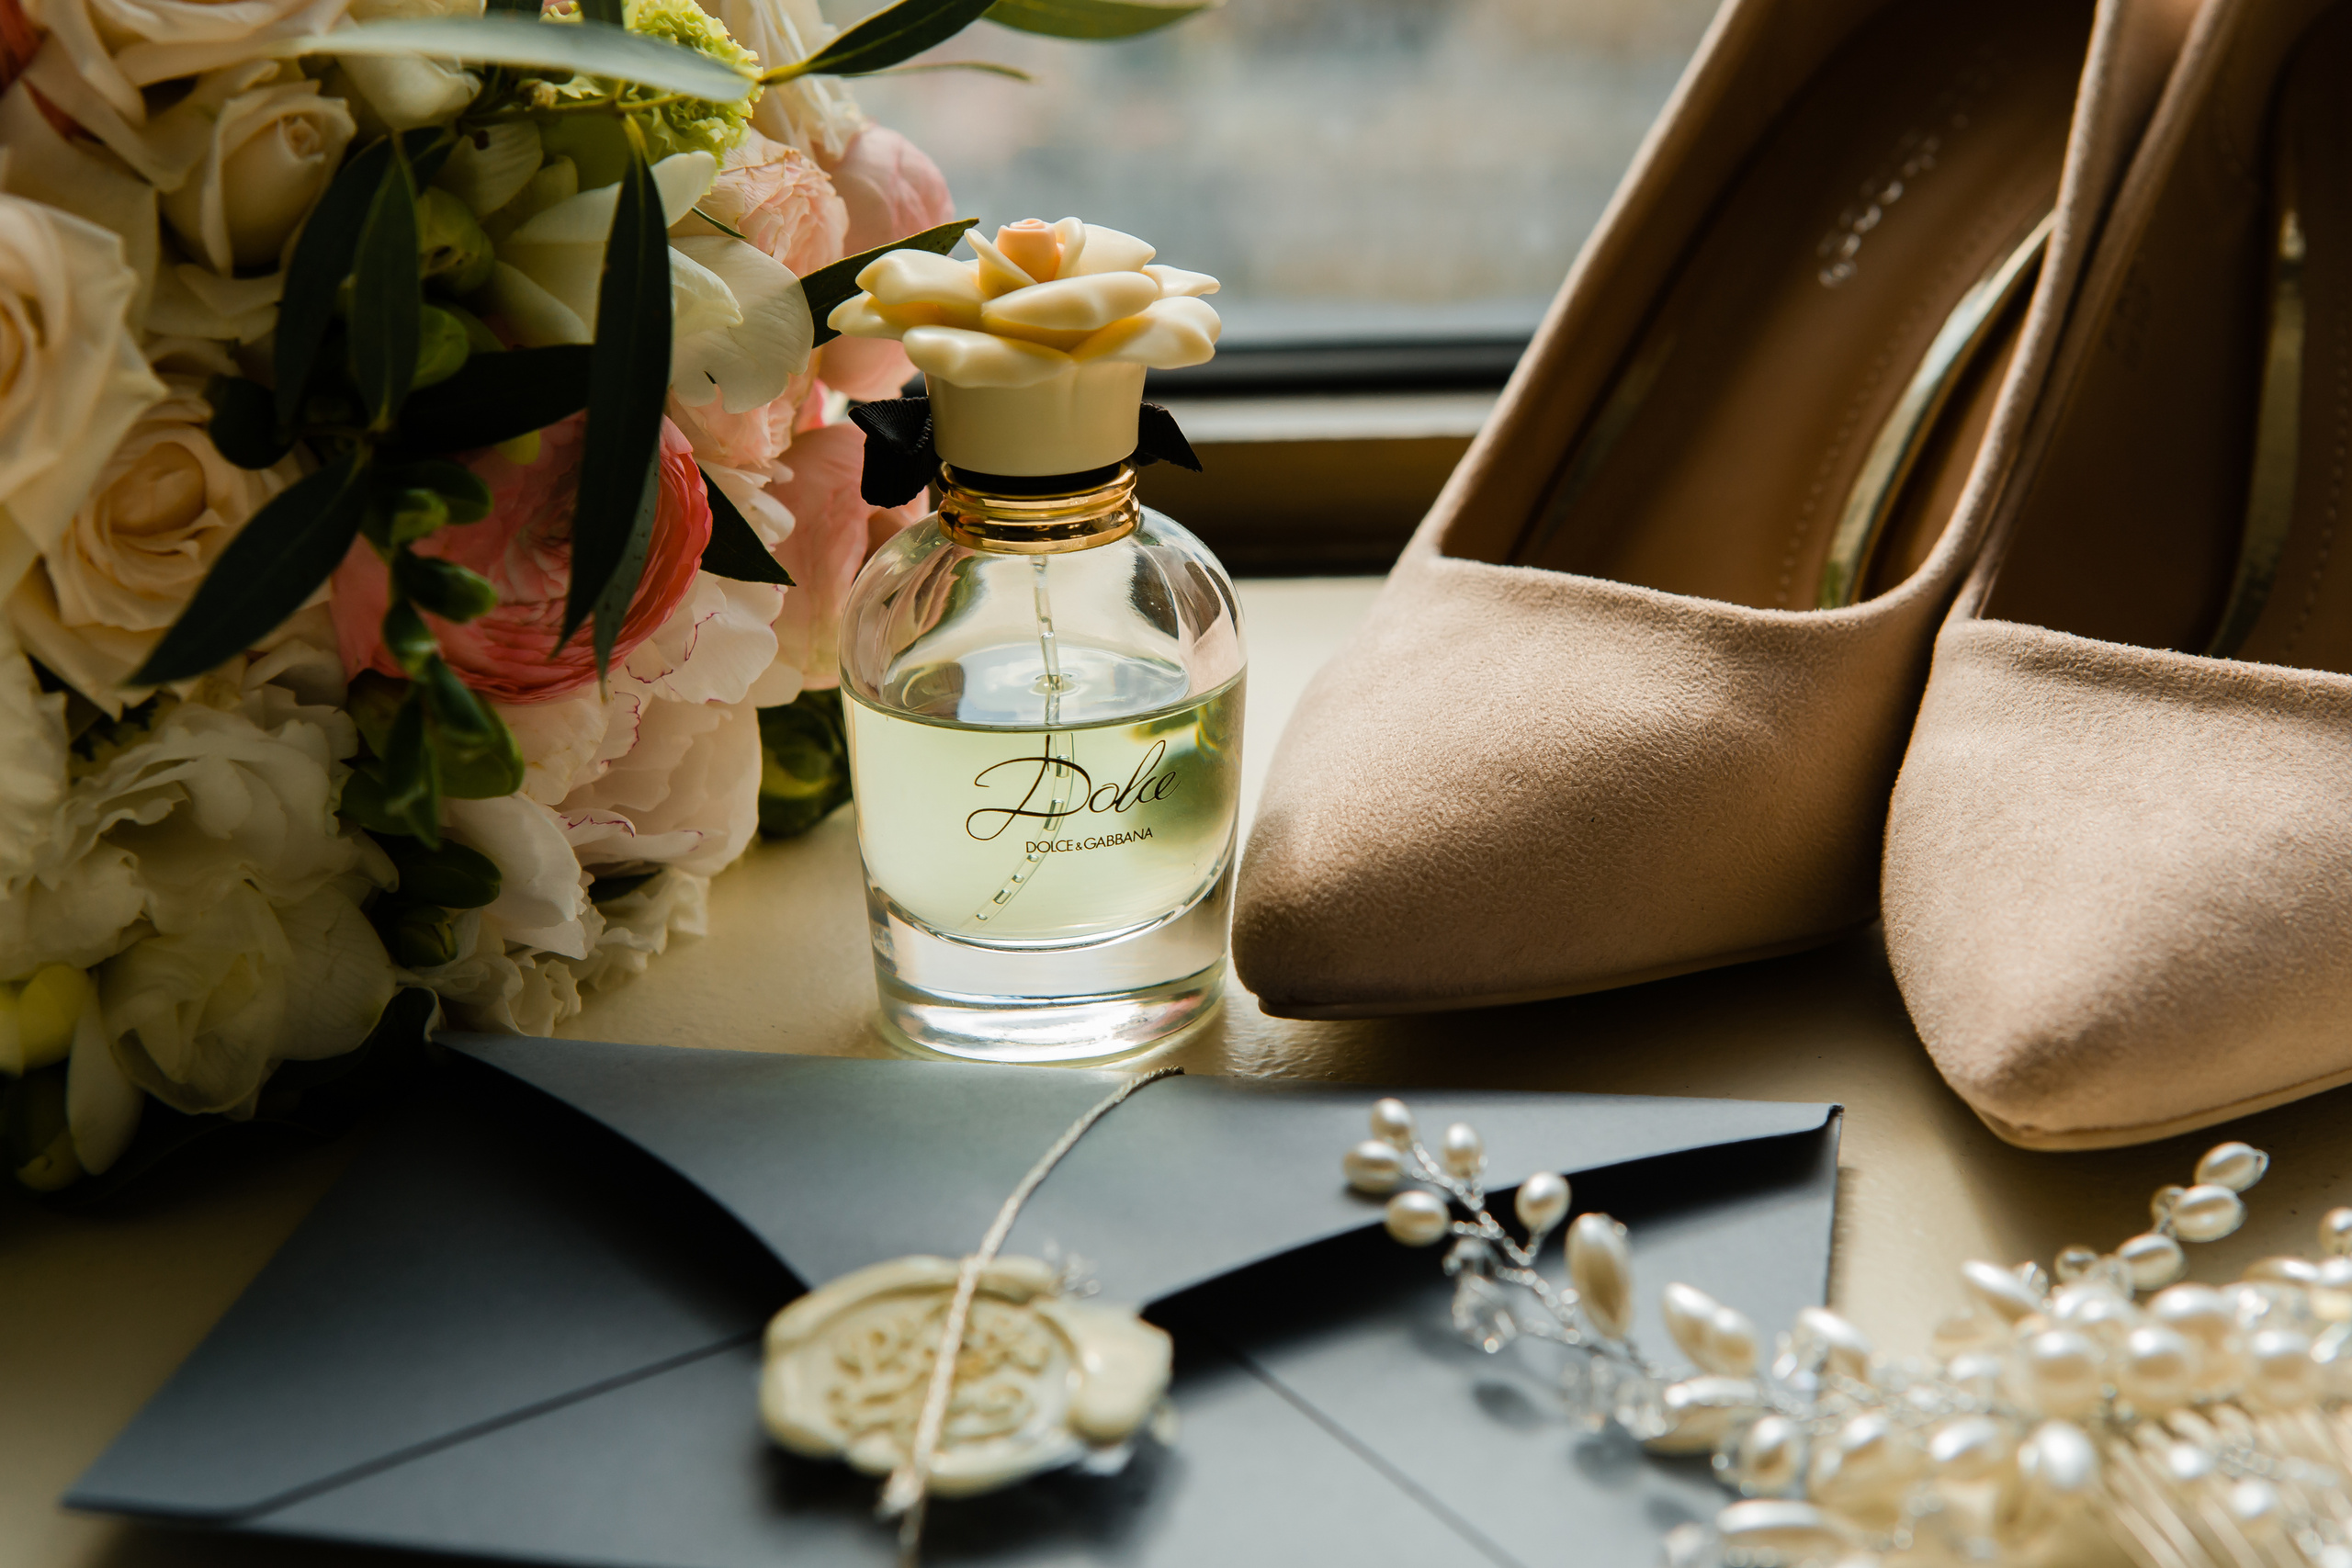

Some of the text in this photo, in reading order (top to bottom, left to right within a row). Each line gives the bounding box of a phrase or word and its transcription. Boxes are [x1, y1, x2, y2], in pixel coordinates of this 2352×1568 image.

[967, 734, 1181, 840] Dolce
[1025, 840, 1073, 853] DOLCE
[1083, 827, 1153, 850] GABBANA
